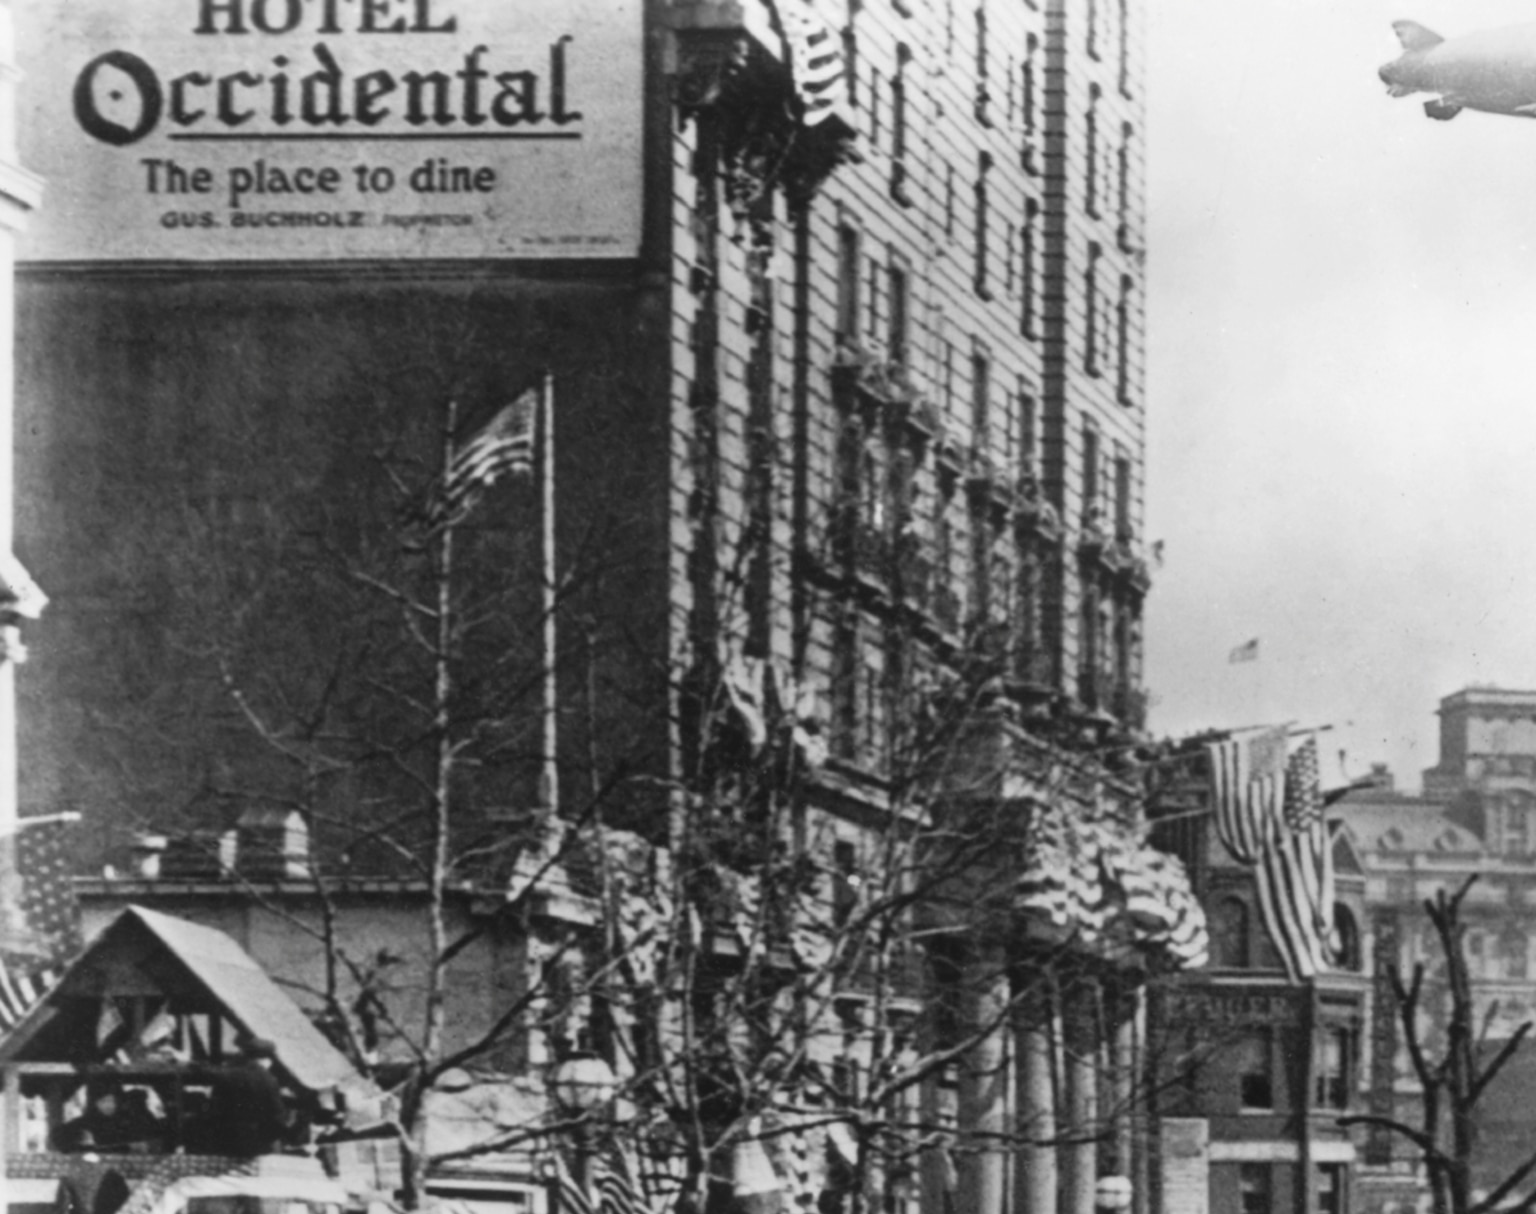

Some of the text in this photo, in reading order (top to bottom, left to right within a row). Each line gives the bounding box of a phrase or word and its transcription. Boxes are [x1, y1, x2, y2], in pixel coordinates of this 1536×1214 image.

[193, 0, 457, 36] HOTEL
[73, 35, 584, 146] Occidental
[140, 157, 498, 209] The place to dine
[159, 210, 221, 231] GUS.
[230, 209, 366, 230] BUCHHOLZ
